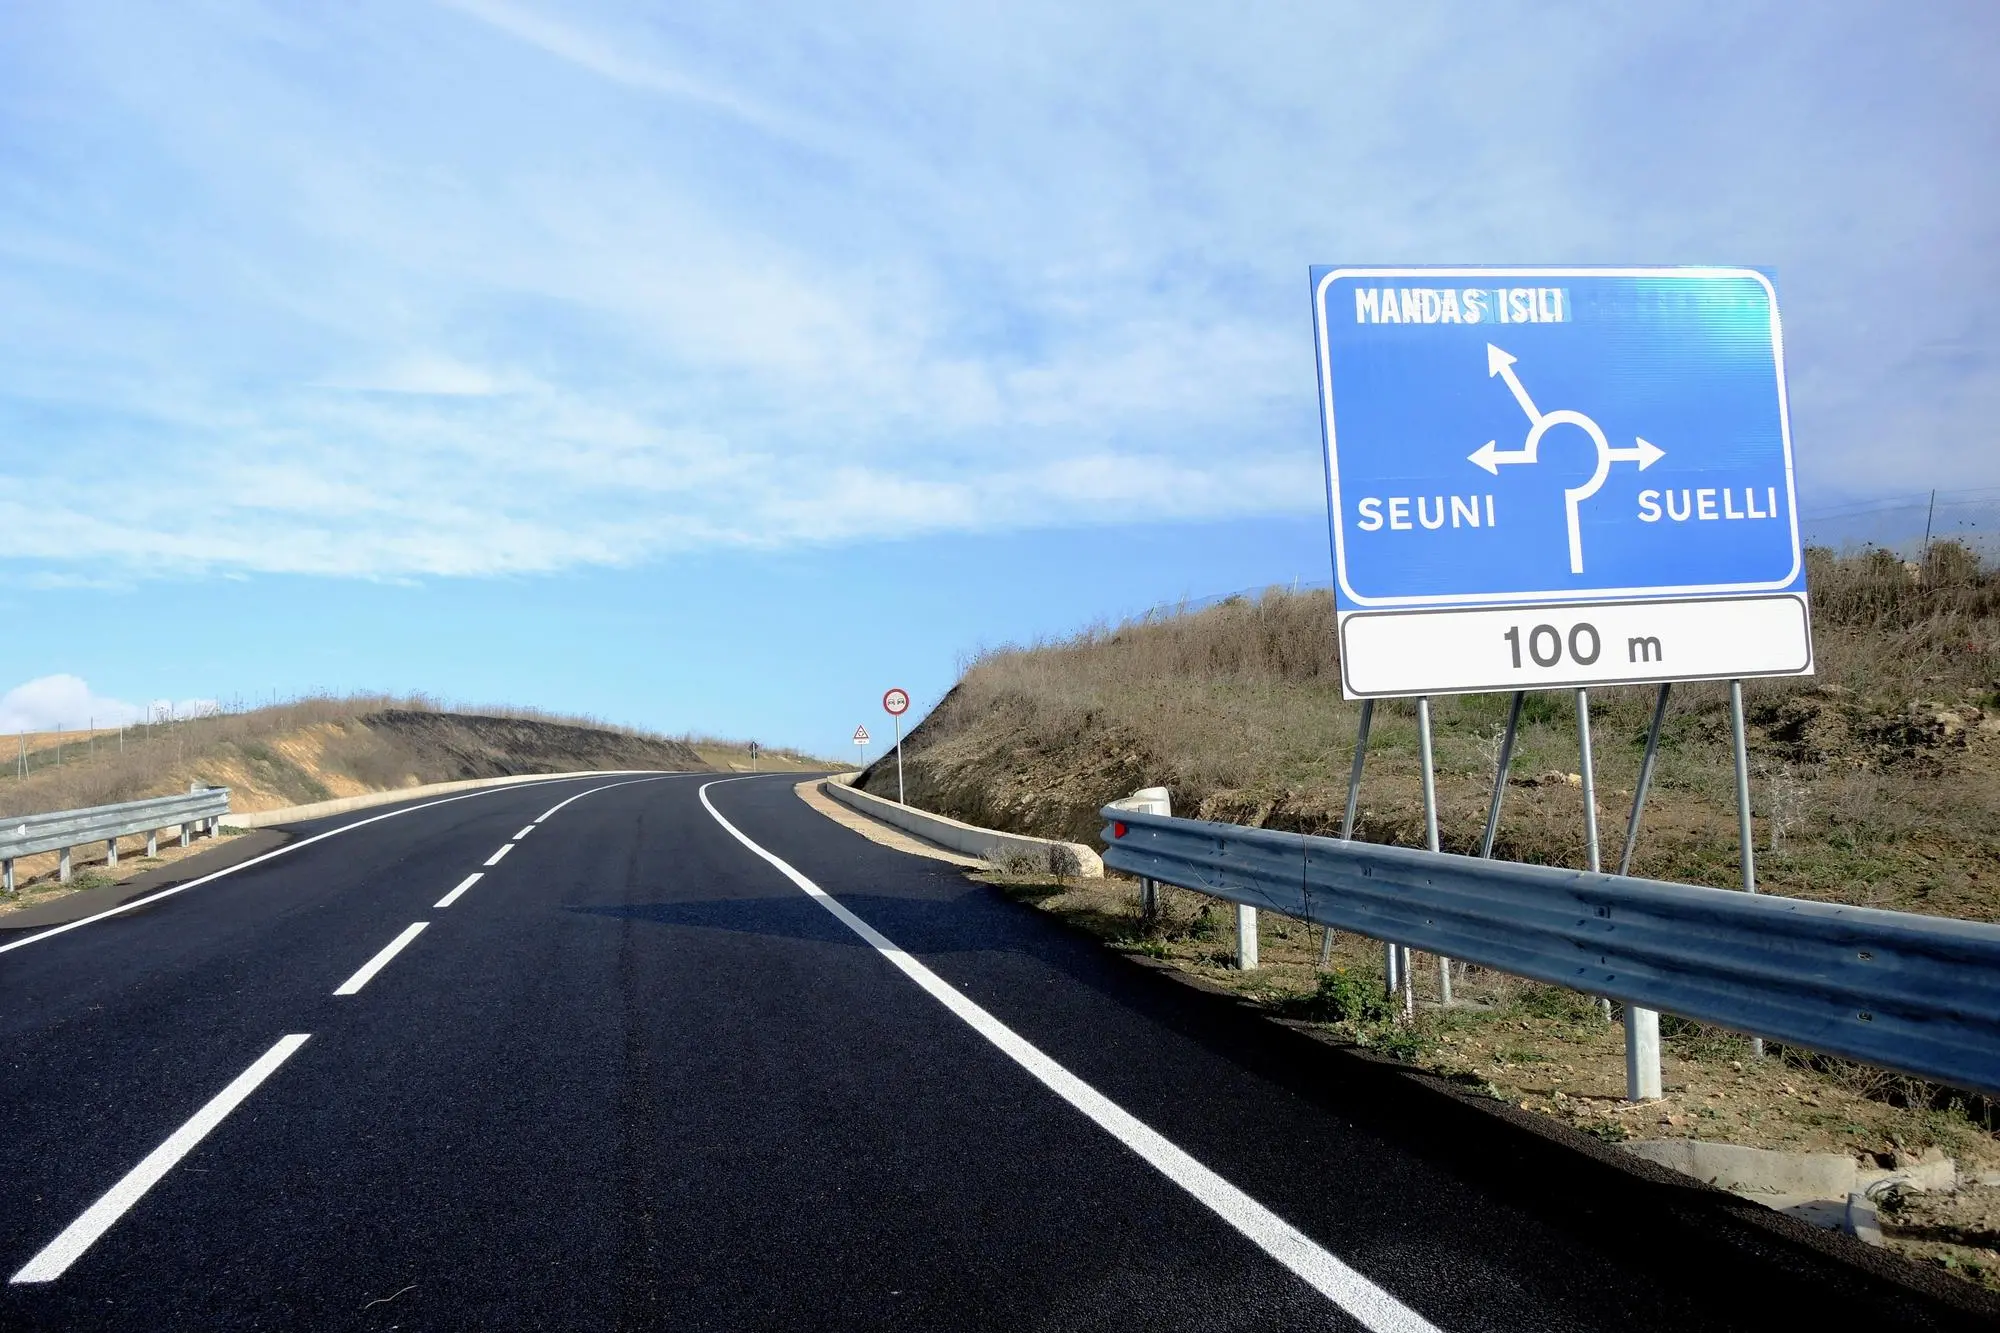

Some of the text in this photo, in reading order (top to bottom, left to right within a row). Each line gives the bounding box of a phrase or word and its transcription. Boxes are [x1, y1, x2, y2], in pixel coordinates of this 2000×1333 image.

[1354, 287, 1564, 324] MANDAS ISILI
[1357, 494, 1496, 531] SEUNI
[1637, 487, 1777, 522] SUELLI
[1503, 622, 1663, 669] 100 m
